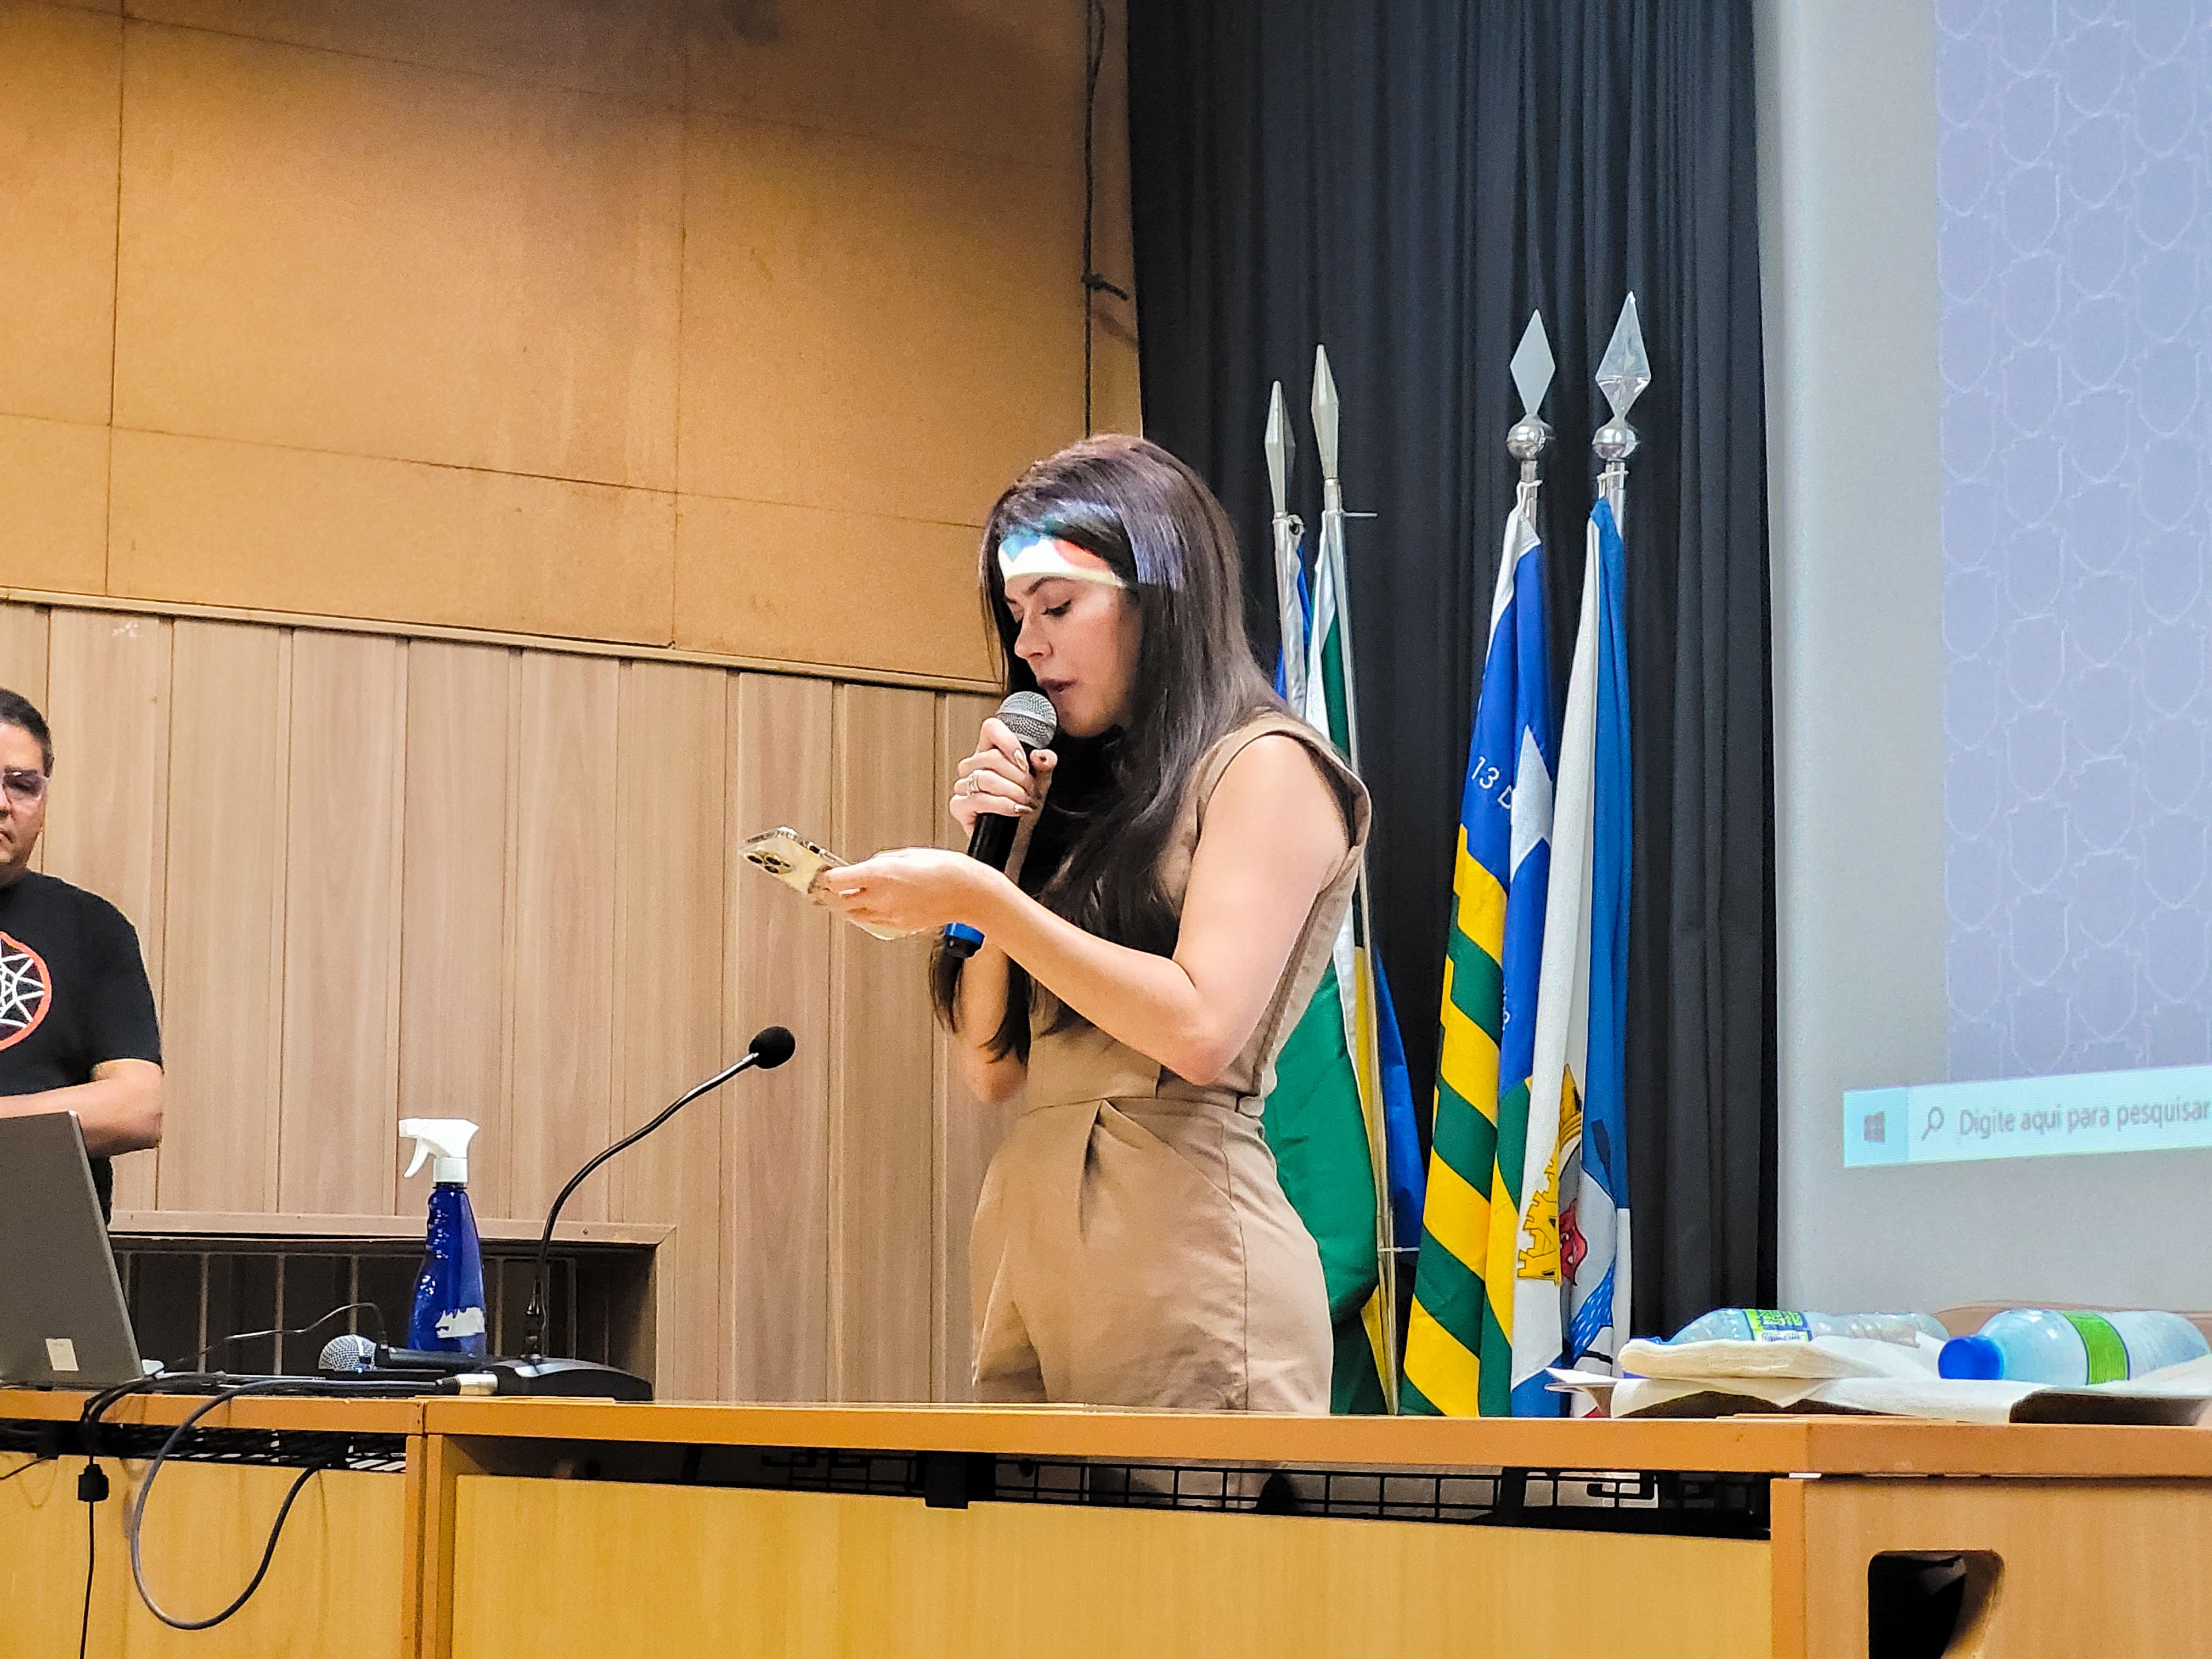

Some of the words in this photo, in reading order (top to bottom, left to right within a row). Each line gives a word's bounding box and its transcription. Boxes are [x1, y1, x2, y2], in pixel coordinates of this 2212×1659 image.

[1471, 756, 1500, 789] 13
[1960, 1107, 2014, 1139] Digite
[2021, 1103, 2061, 1135] aqui
[2067, 1106, 2109, 1133] para
[2117, 1094, 2210, 1132] pesquisar
